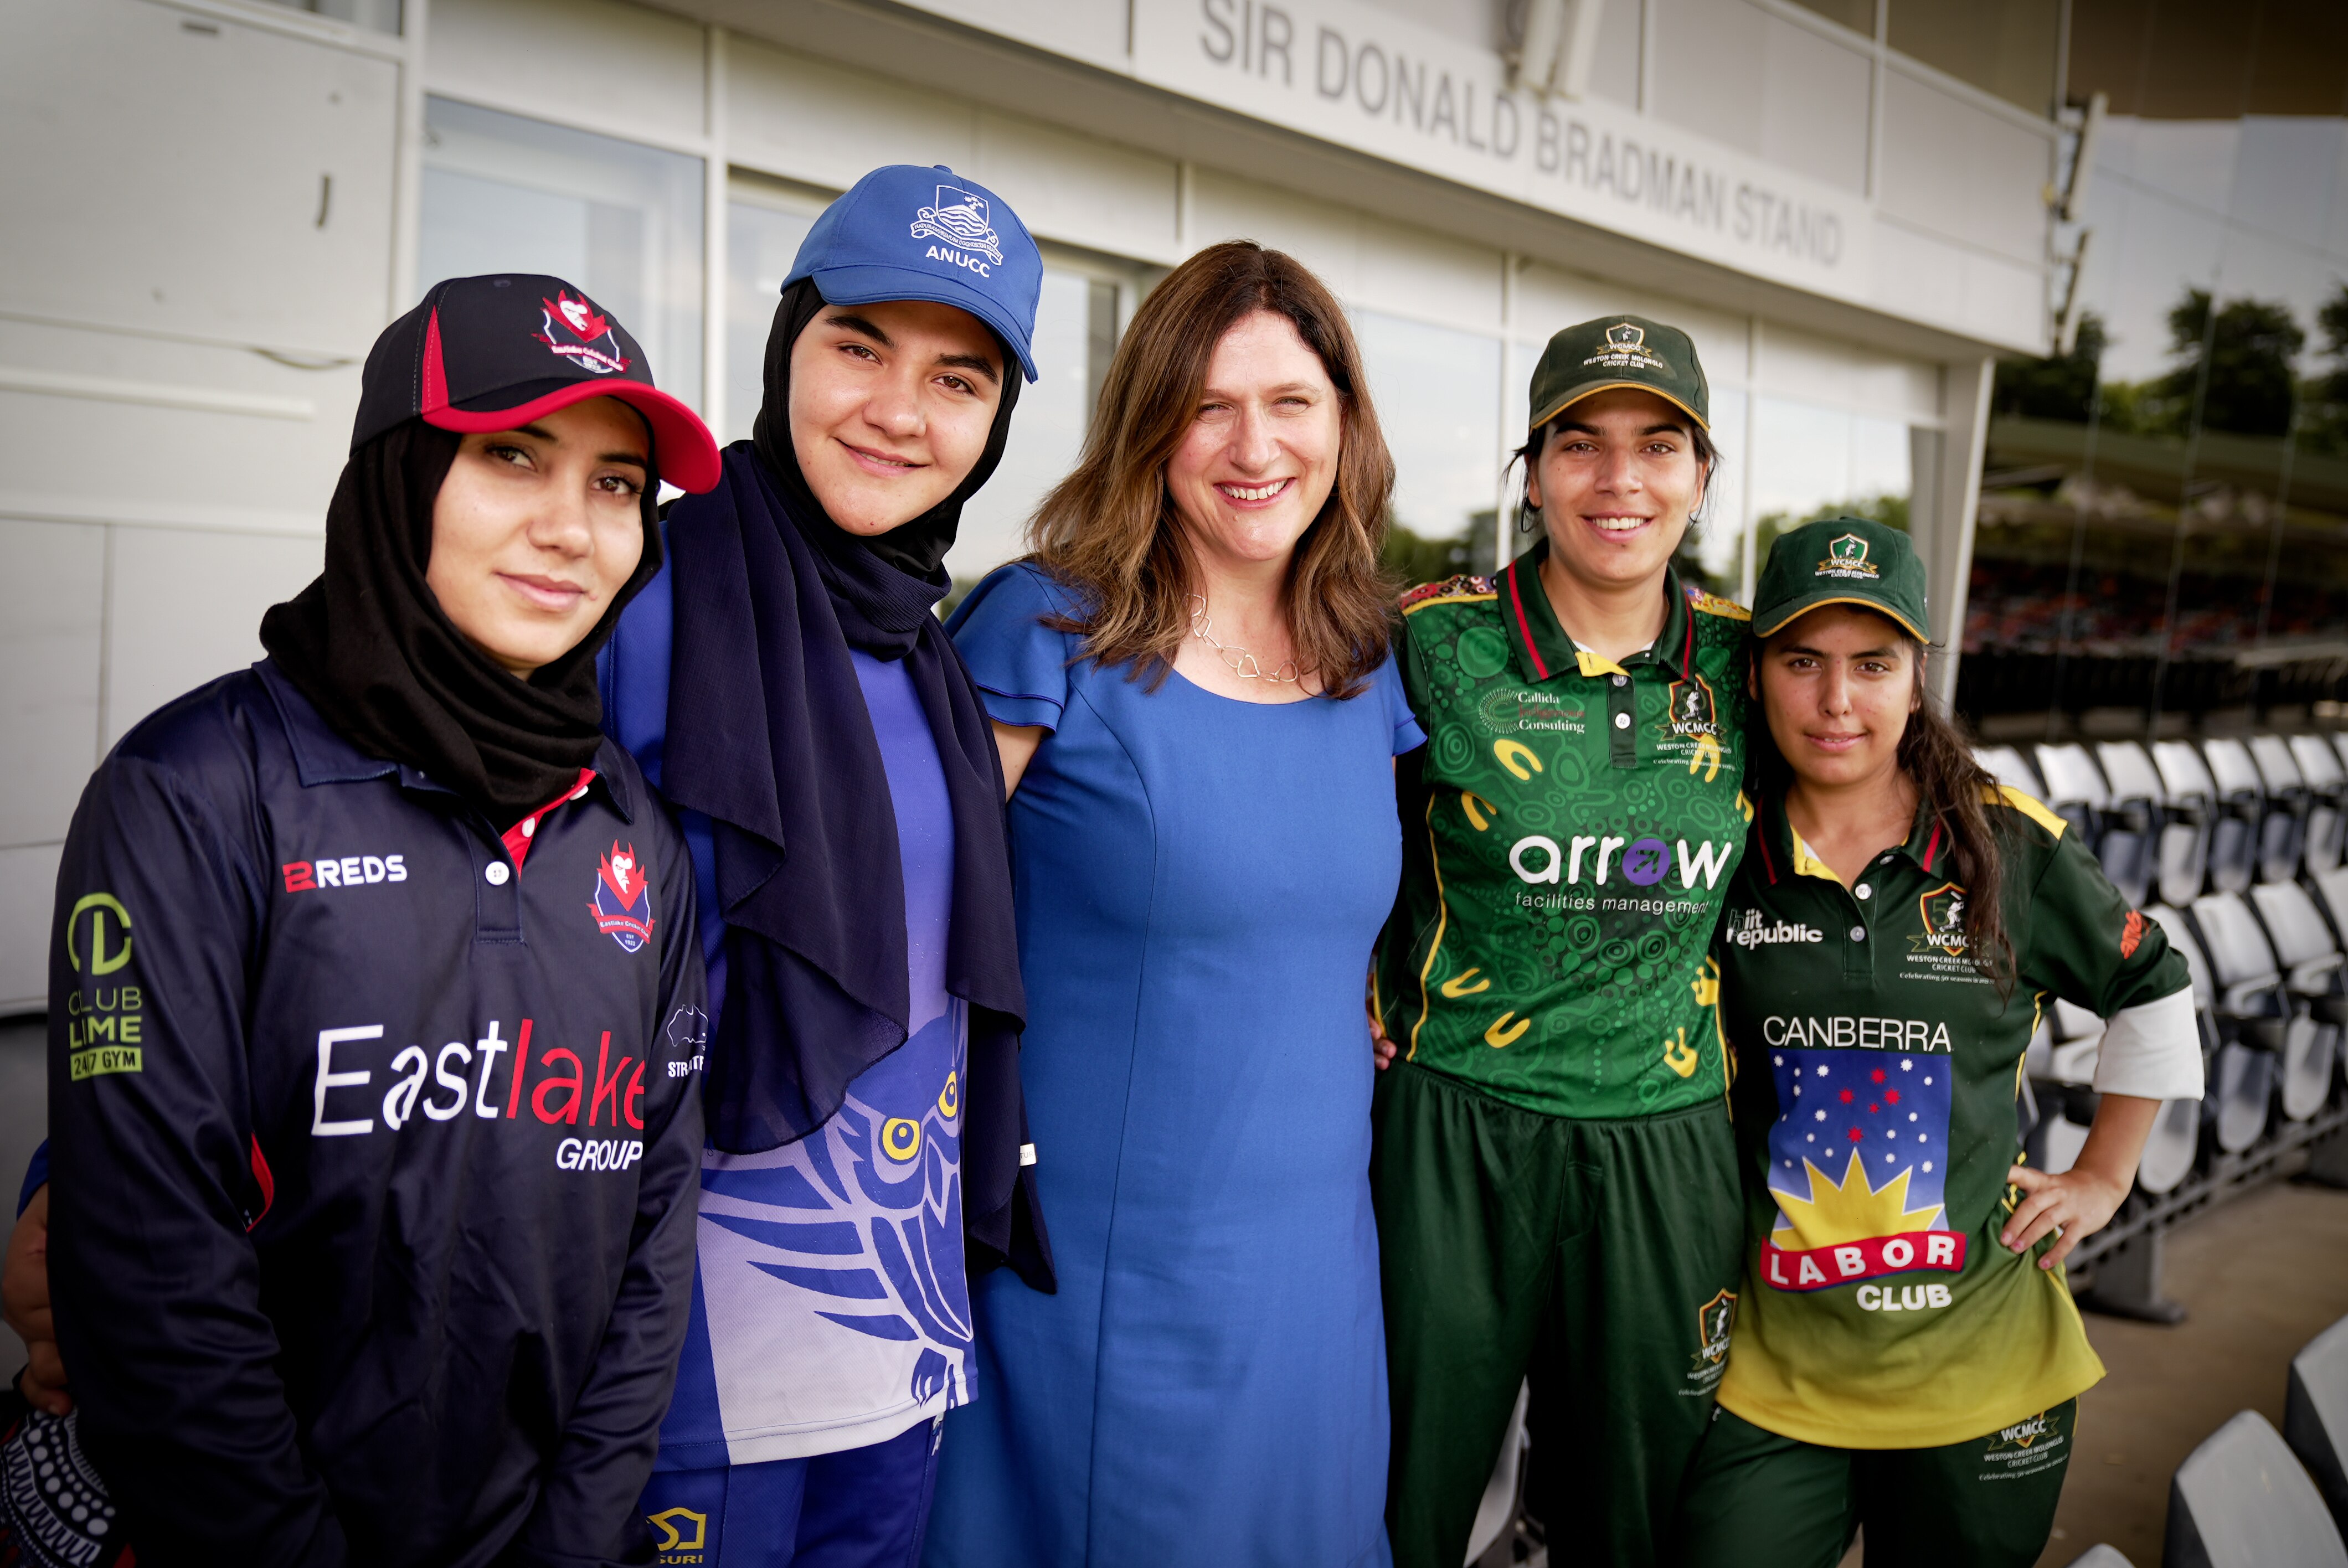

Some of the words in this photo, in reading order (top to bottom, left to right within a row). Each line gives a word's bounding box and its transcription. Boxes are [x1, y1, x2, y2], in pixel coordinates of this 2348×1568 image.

[1199, 0, 1294, 87] SIR
[1316, 26, 1521, 161] DONALD
[1534, 111, 1727, 234] BRADMAN
[1733, 180, 1845, 270] STAND
[925, 245, 990, 278] ANUCC
[1518, 692, 1559, 704] Callida
[1519, 719, 1585, 735] Consulting
[1672, 721, 1717, 736] WCMCC
[1656, 742, 1685, 751] WESTON
[1516, 891, 1595, 910] facilities
[1602, 897, 1709, 915] management
[1726, 920, 1823, 950] republic
[1927, 933, 1978, 948] WCMC
[1906, 955, 1939, 963] WESTON
[1932, 963, 1960, 972] CRICKET
[1899, 972, 1939, 982] Celebrating
[69, 986, 142, 1016] CLUB
[69, 1015, 142, 1050] LIME
[1763, 1015, 1951, 1052] CANBERRA
[102, 1051, 136, 1069] GYM
[556, 1138, 643, 1171] GROUP
[1770, 1235, 1956, 1285] LABOR
[1857, 1284, 1952, 1311] CLUB
[2001, 1419, 2047, 1442] WCMCC
[1984, 1451, 2014, 1462] WESTON
